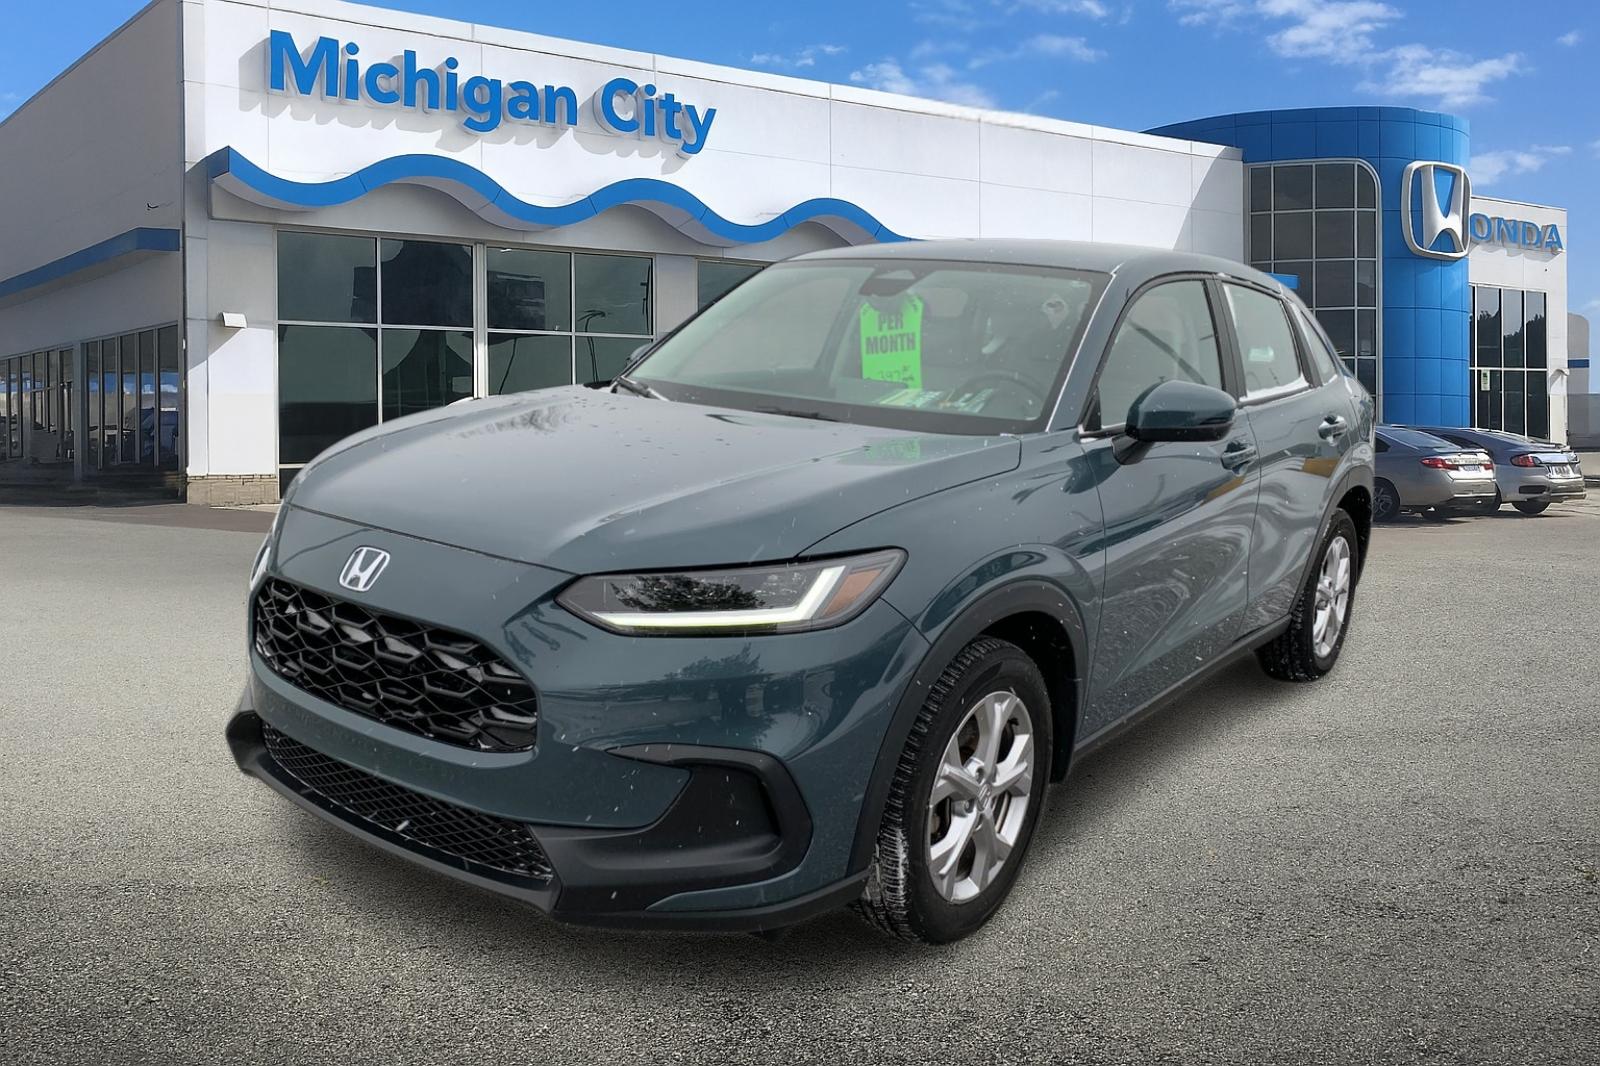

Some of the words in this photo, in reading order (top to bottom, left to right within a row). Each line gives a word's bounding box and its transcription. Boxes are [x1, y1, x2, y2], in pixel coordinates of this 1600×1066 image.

[269, 29, 578, 133] Michigan
[598, 77, 717, 154] City
[1469, 212, 1564, 251] ONDA
[877, 312, 905, 332] PER
[864, 332, 917, 355] MONTH
